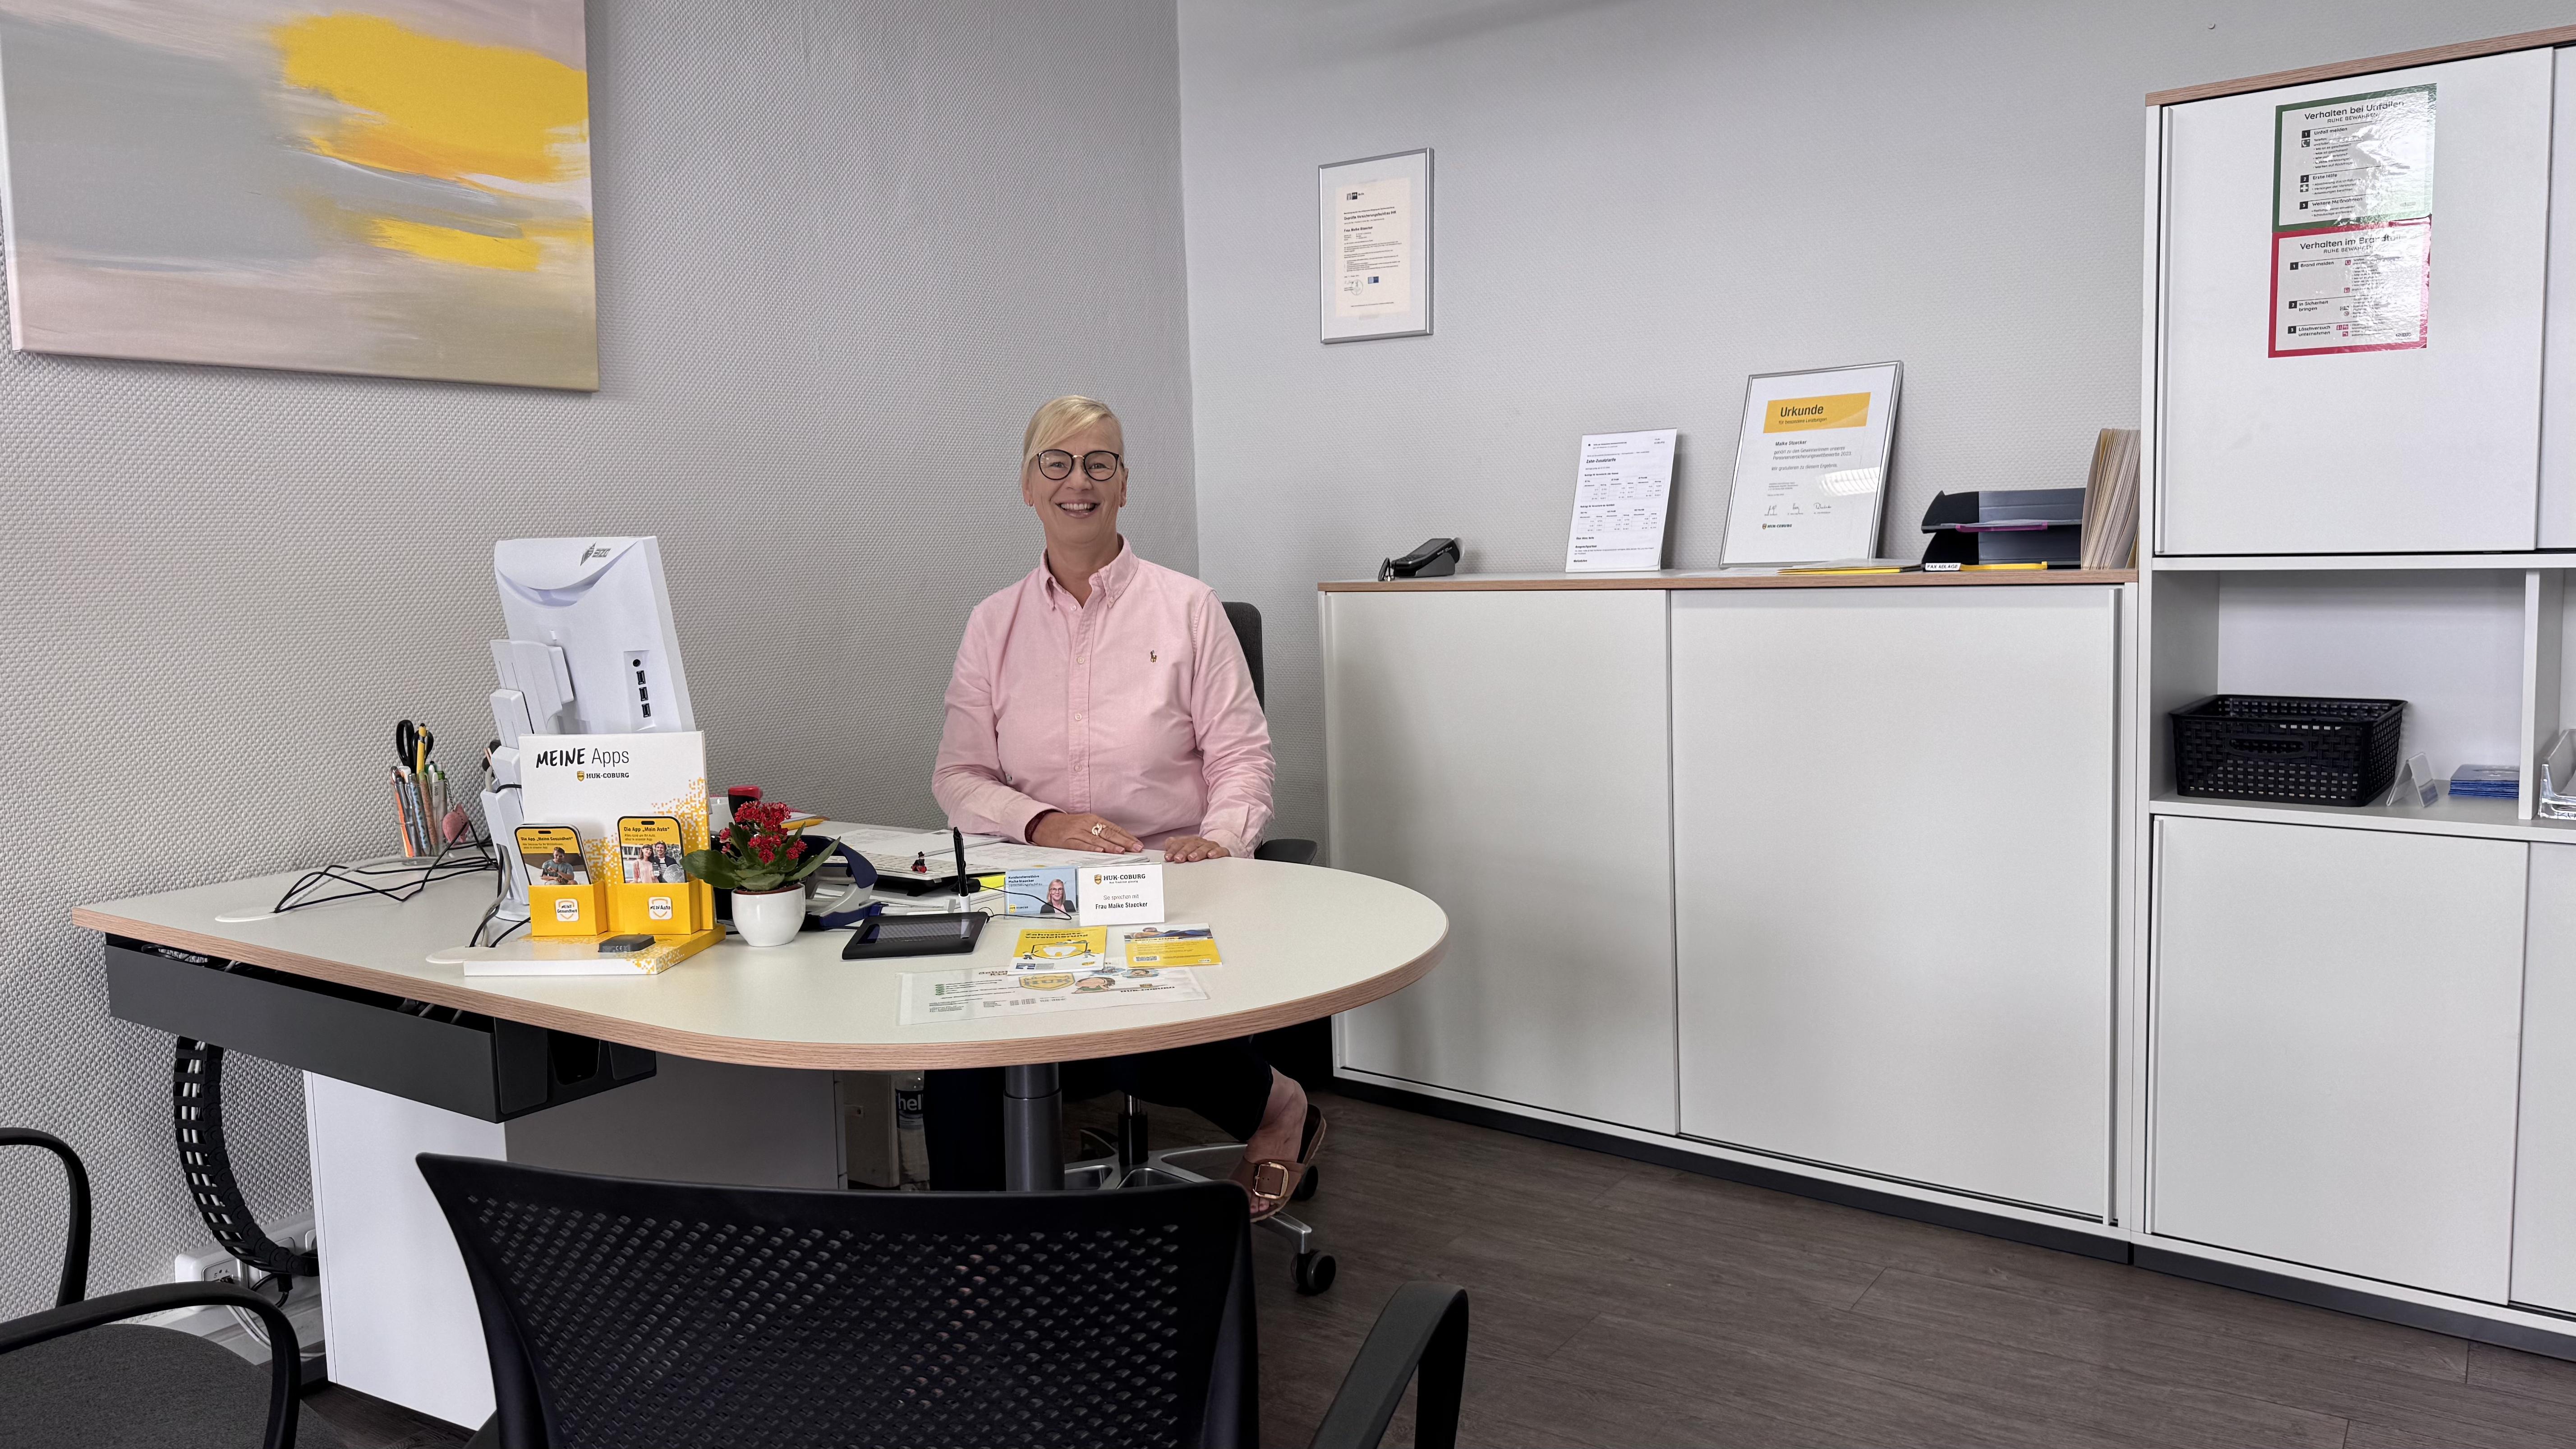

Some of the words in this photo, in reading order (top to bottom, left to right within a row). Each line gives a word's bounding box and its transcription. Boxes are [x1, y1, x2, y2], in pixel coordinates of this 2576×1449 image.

[2305, 110, 2347, 120] Verhalten
[2350, 105, 2364, 114] bei
[2366, 101, 2404, 111] Unfällen
[2345, 113, 2378, 121] BEWAHREN
[2300, 240, 2342, 249] Verhalten
[1780, 404, 1823, 417] Urkunde
[536, 748, 585, 768] MEINE
[592, 748, 629, 767] Apps
[898, 1093, 923, 1110] hel
